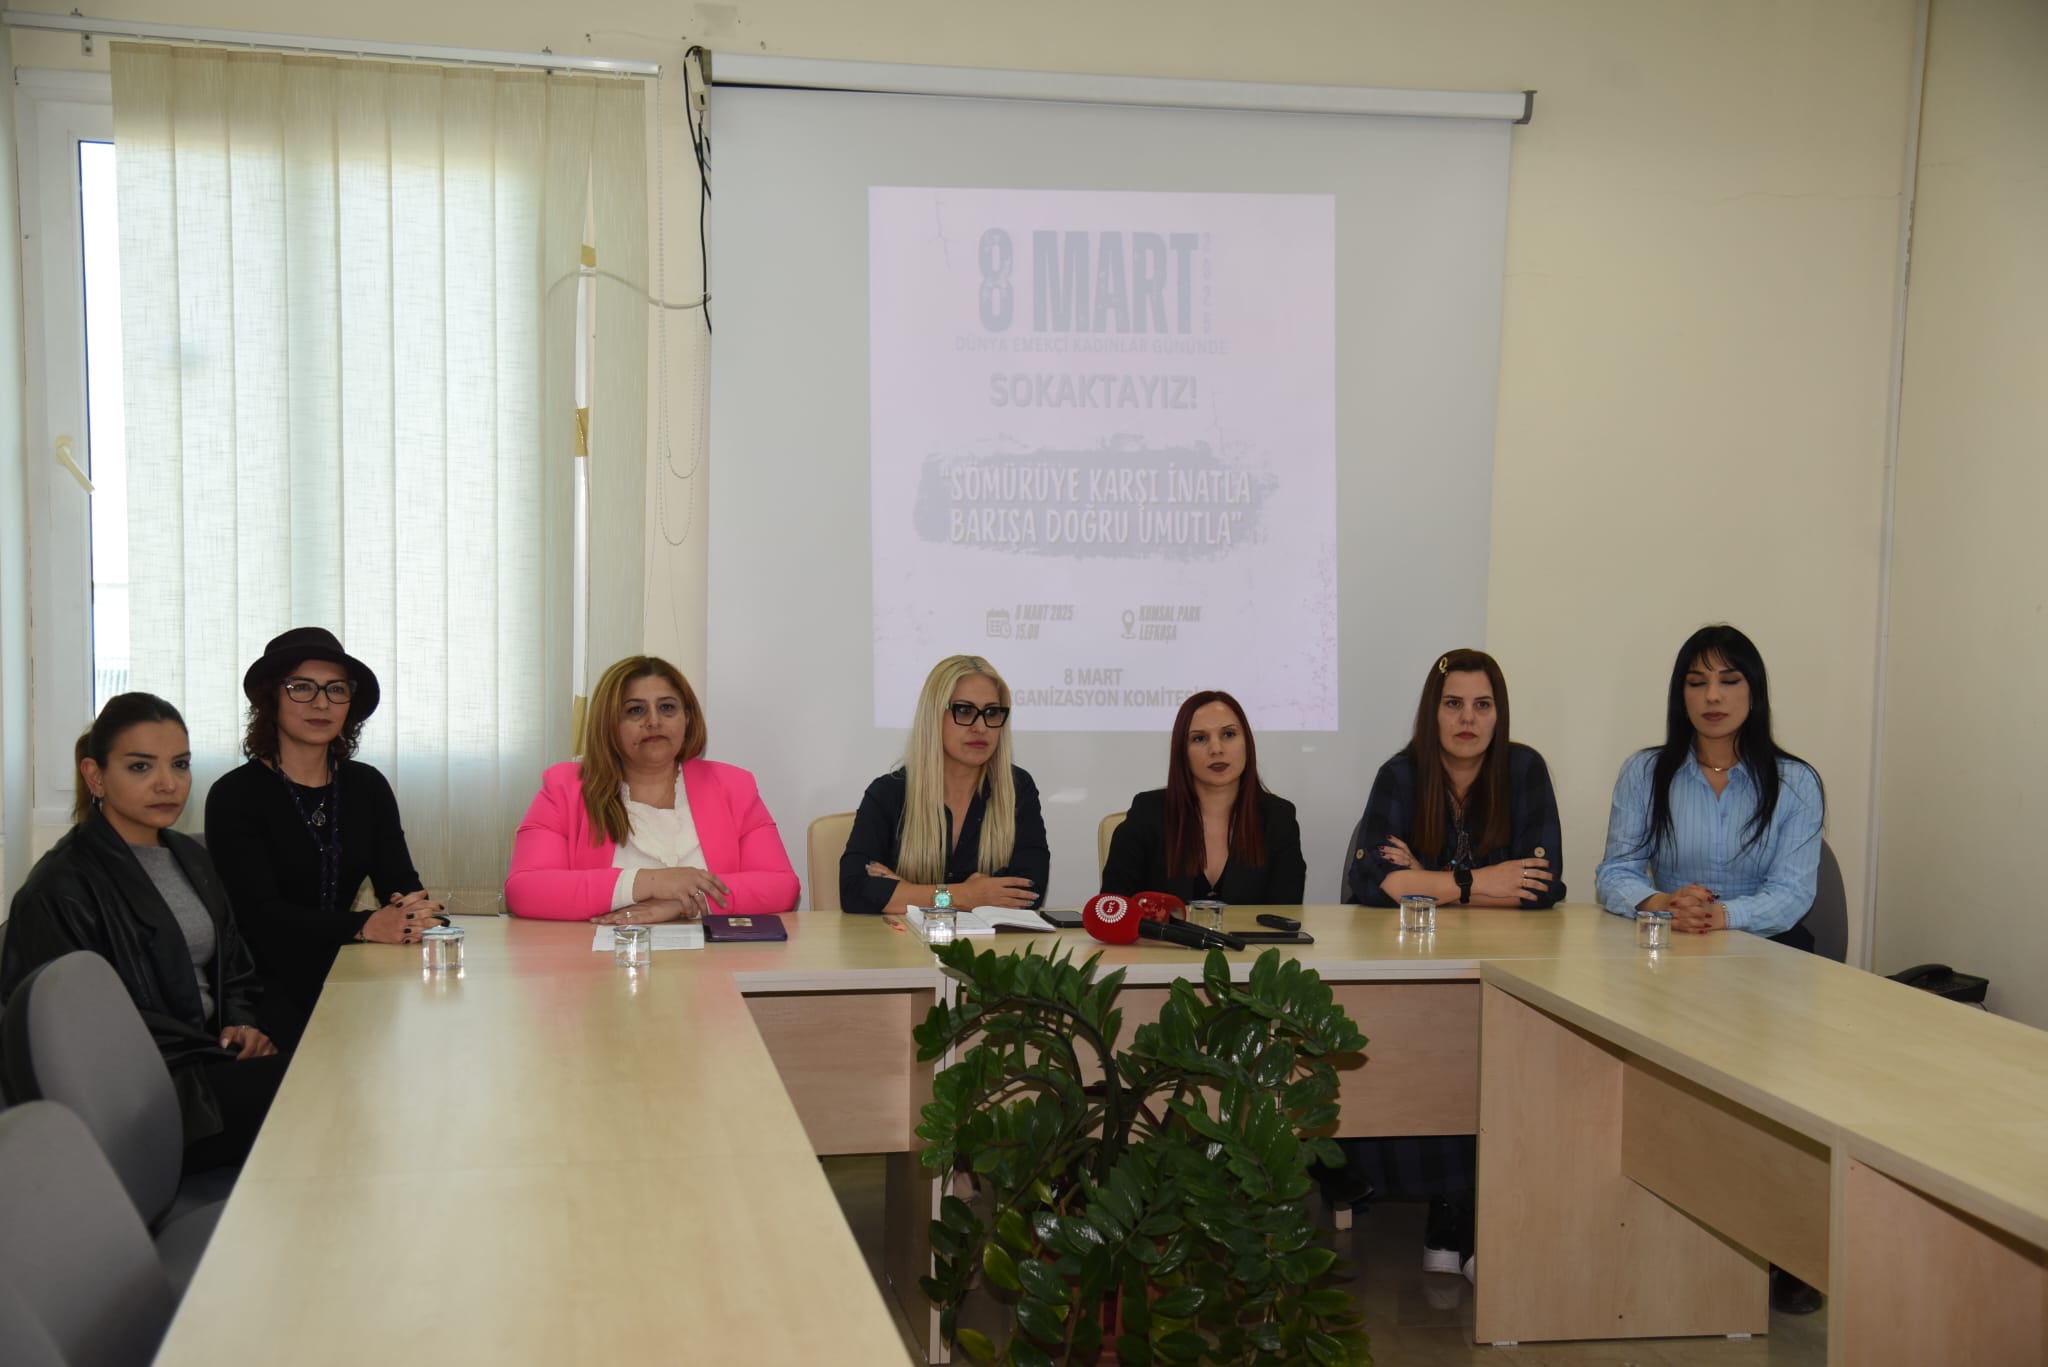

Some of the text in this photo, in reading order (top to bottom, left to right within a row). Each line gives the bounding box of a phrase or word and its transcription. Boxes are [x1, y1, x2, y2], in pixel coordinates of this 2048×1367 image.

[978, 227, 1199, 334] 8 MART
[955, 334, 1008, 352] DÜNYA
[989, 372, 1198, 409] SOKAKTAYIZ!
[1088, 466, 1158, 510] KARŞI
[1167, 463, 1251, 504] İNATLA
[950, 508, 1037, 549] BARIŞA
[1046, 503, 1128, 543] DOĞRU
[1064, 668, 1123, 685] 8 MART
